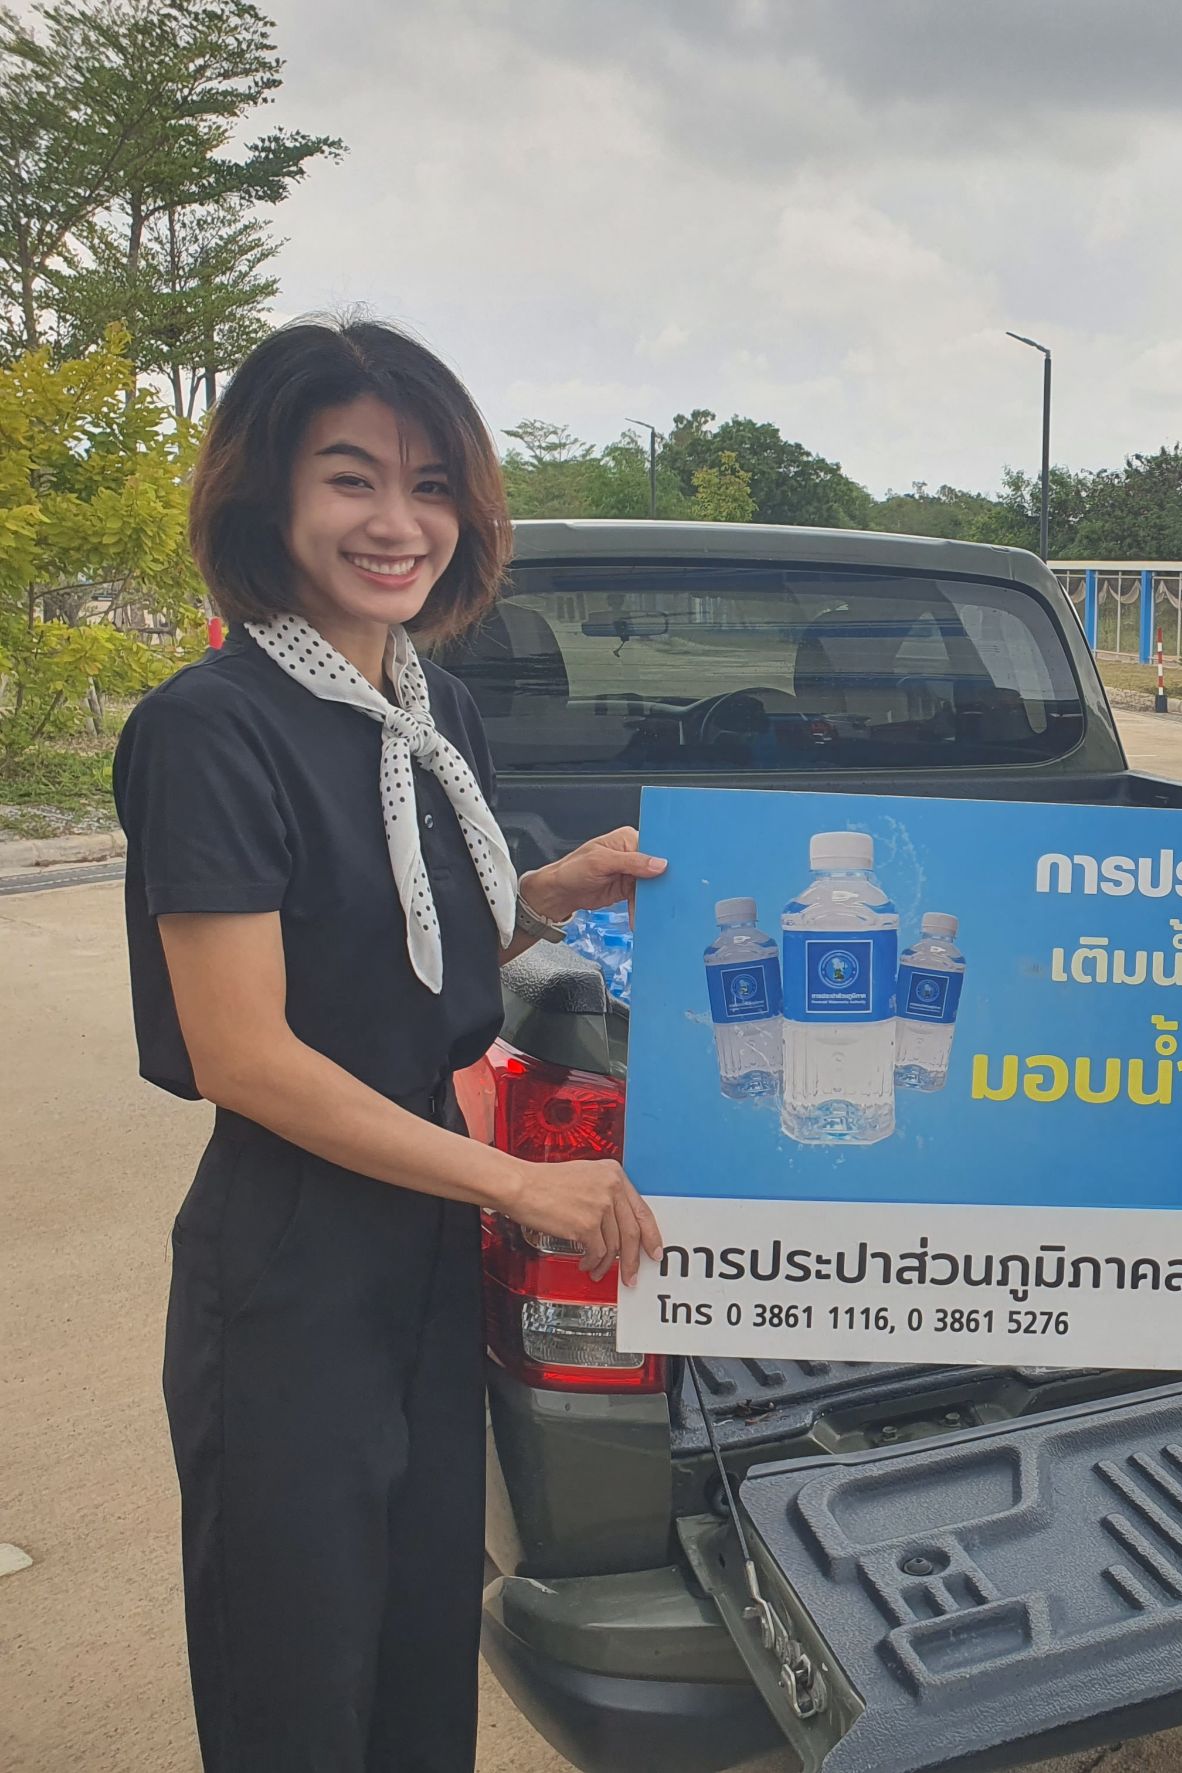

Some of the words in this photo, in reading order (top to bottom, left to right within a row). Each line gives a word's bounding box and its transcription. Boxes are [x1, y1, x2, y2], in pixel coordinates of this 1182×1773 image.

[657, 1294, 713, 1325] โทร
[726, 1302, 742, 1327] 0
[752, 1303, 813, 1329] 3861
[828, 1305, 896, 1334] 1116,
[907, 1306, 923, 1331] 0
[934, 1308, 995, 1333] 3861
[1007, 1310, 1069, 1335] 5276
